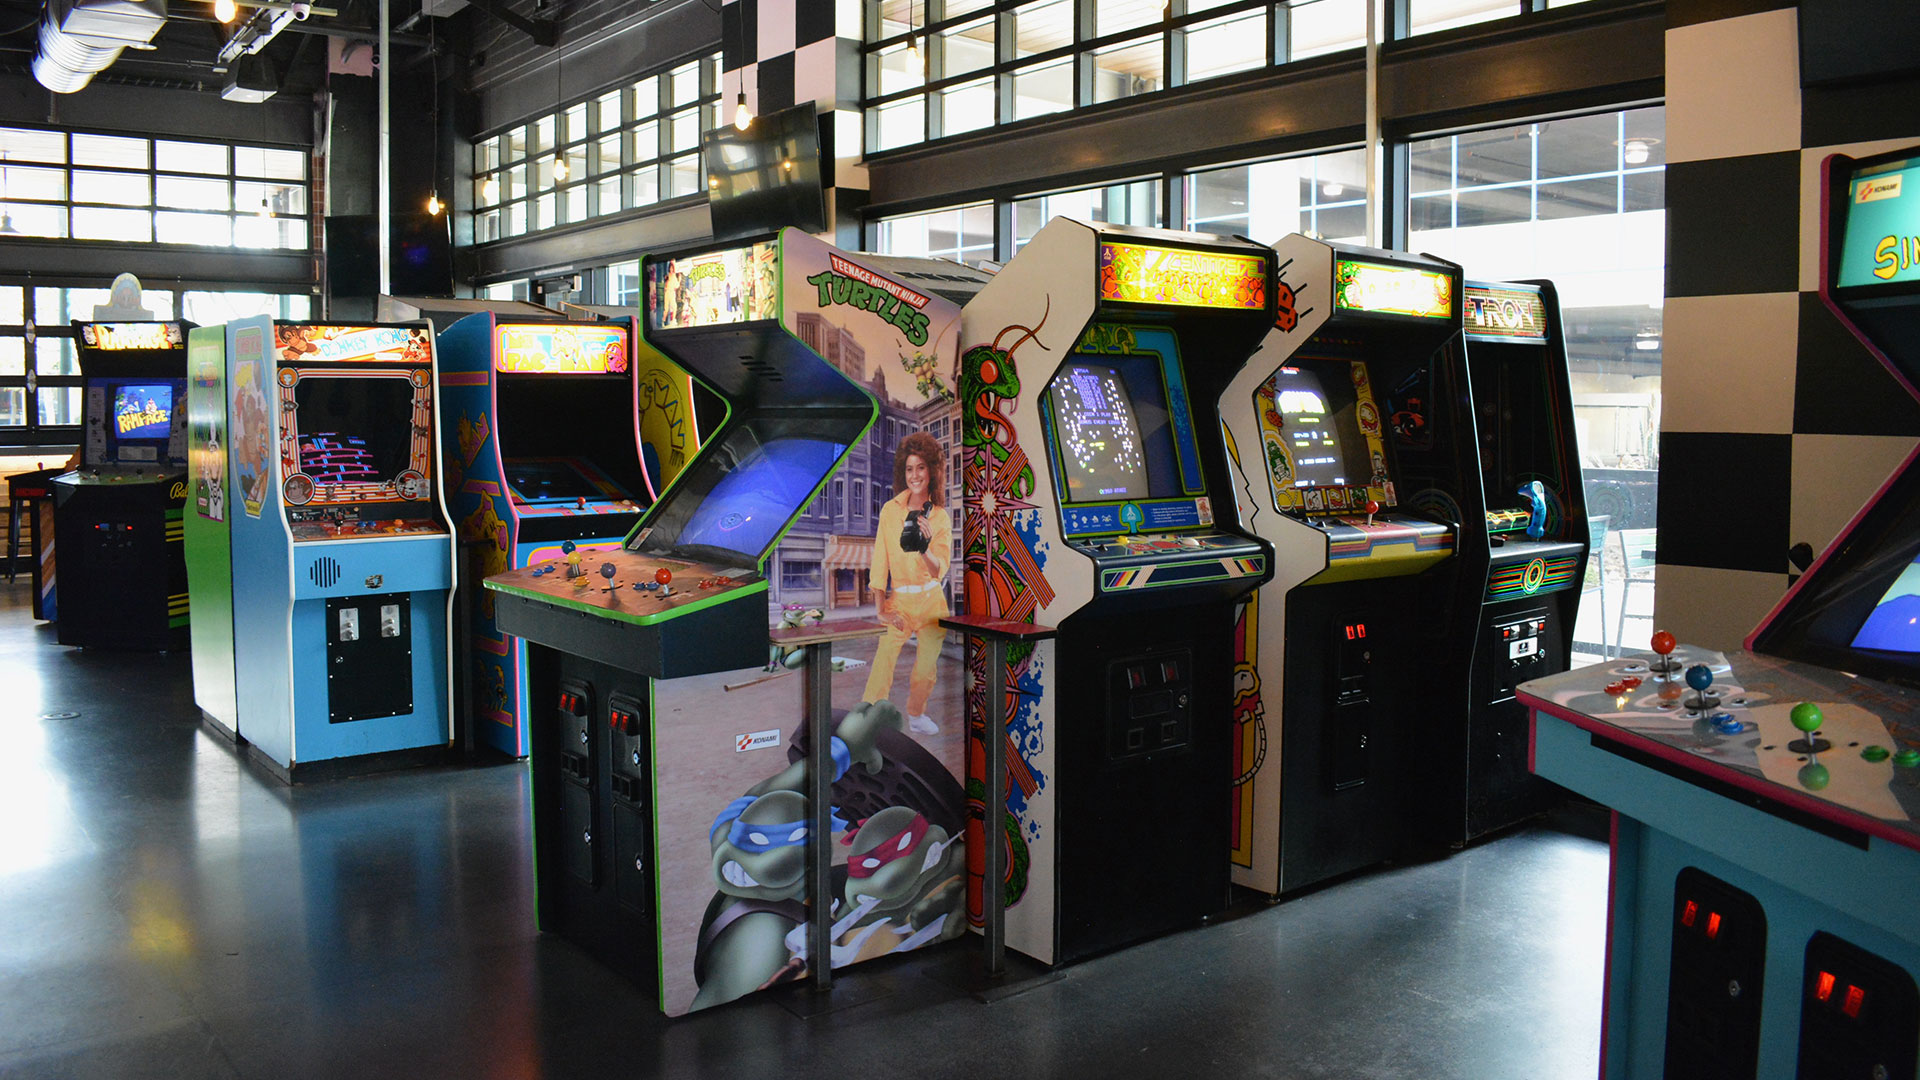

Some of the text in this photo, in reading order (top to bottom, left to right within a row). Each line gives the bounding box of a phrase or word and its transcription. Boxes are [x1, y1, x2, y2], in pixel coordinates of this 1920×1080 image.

[1874, 183, 1898, 193] KONAMI
[688, 262, 726, 287] TURTLES
[1168, 253, 1259, 278] CENTIPEDE
[832, 257, 926, 307] TEENAGE MUTANT NINJA
[806, 270, 931, 347] TURTLES
[1468, 295, 1535, 328] TRON
[320, 328, 409, 357] DONKEY KONG
[117, 409, 168, 433] RAMPAGE
[753, 735, 777, 744] KONAMI
